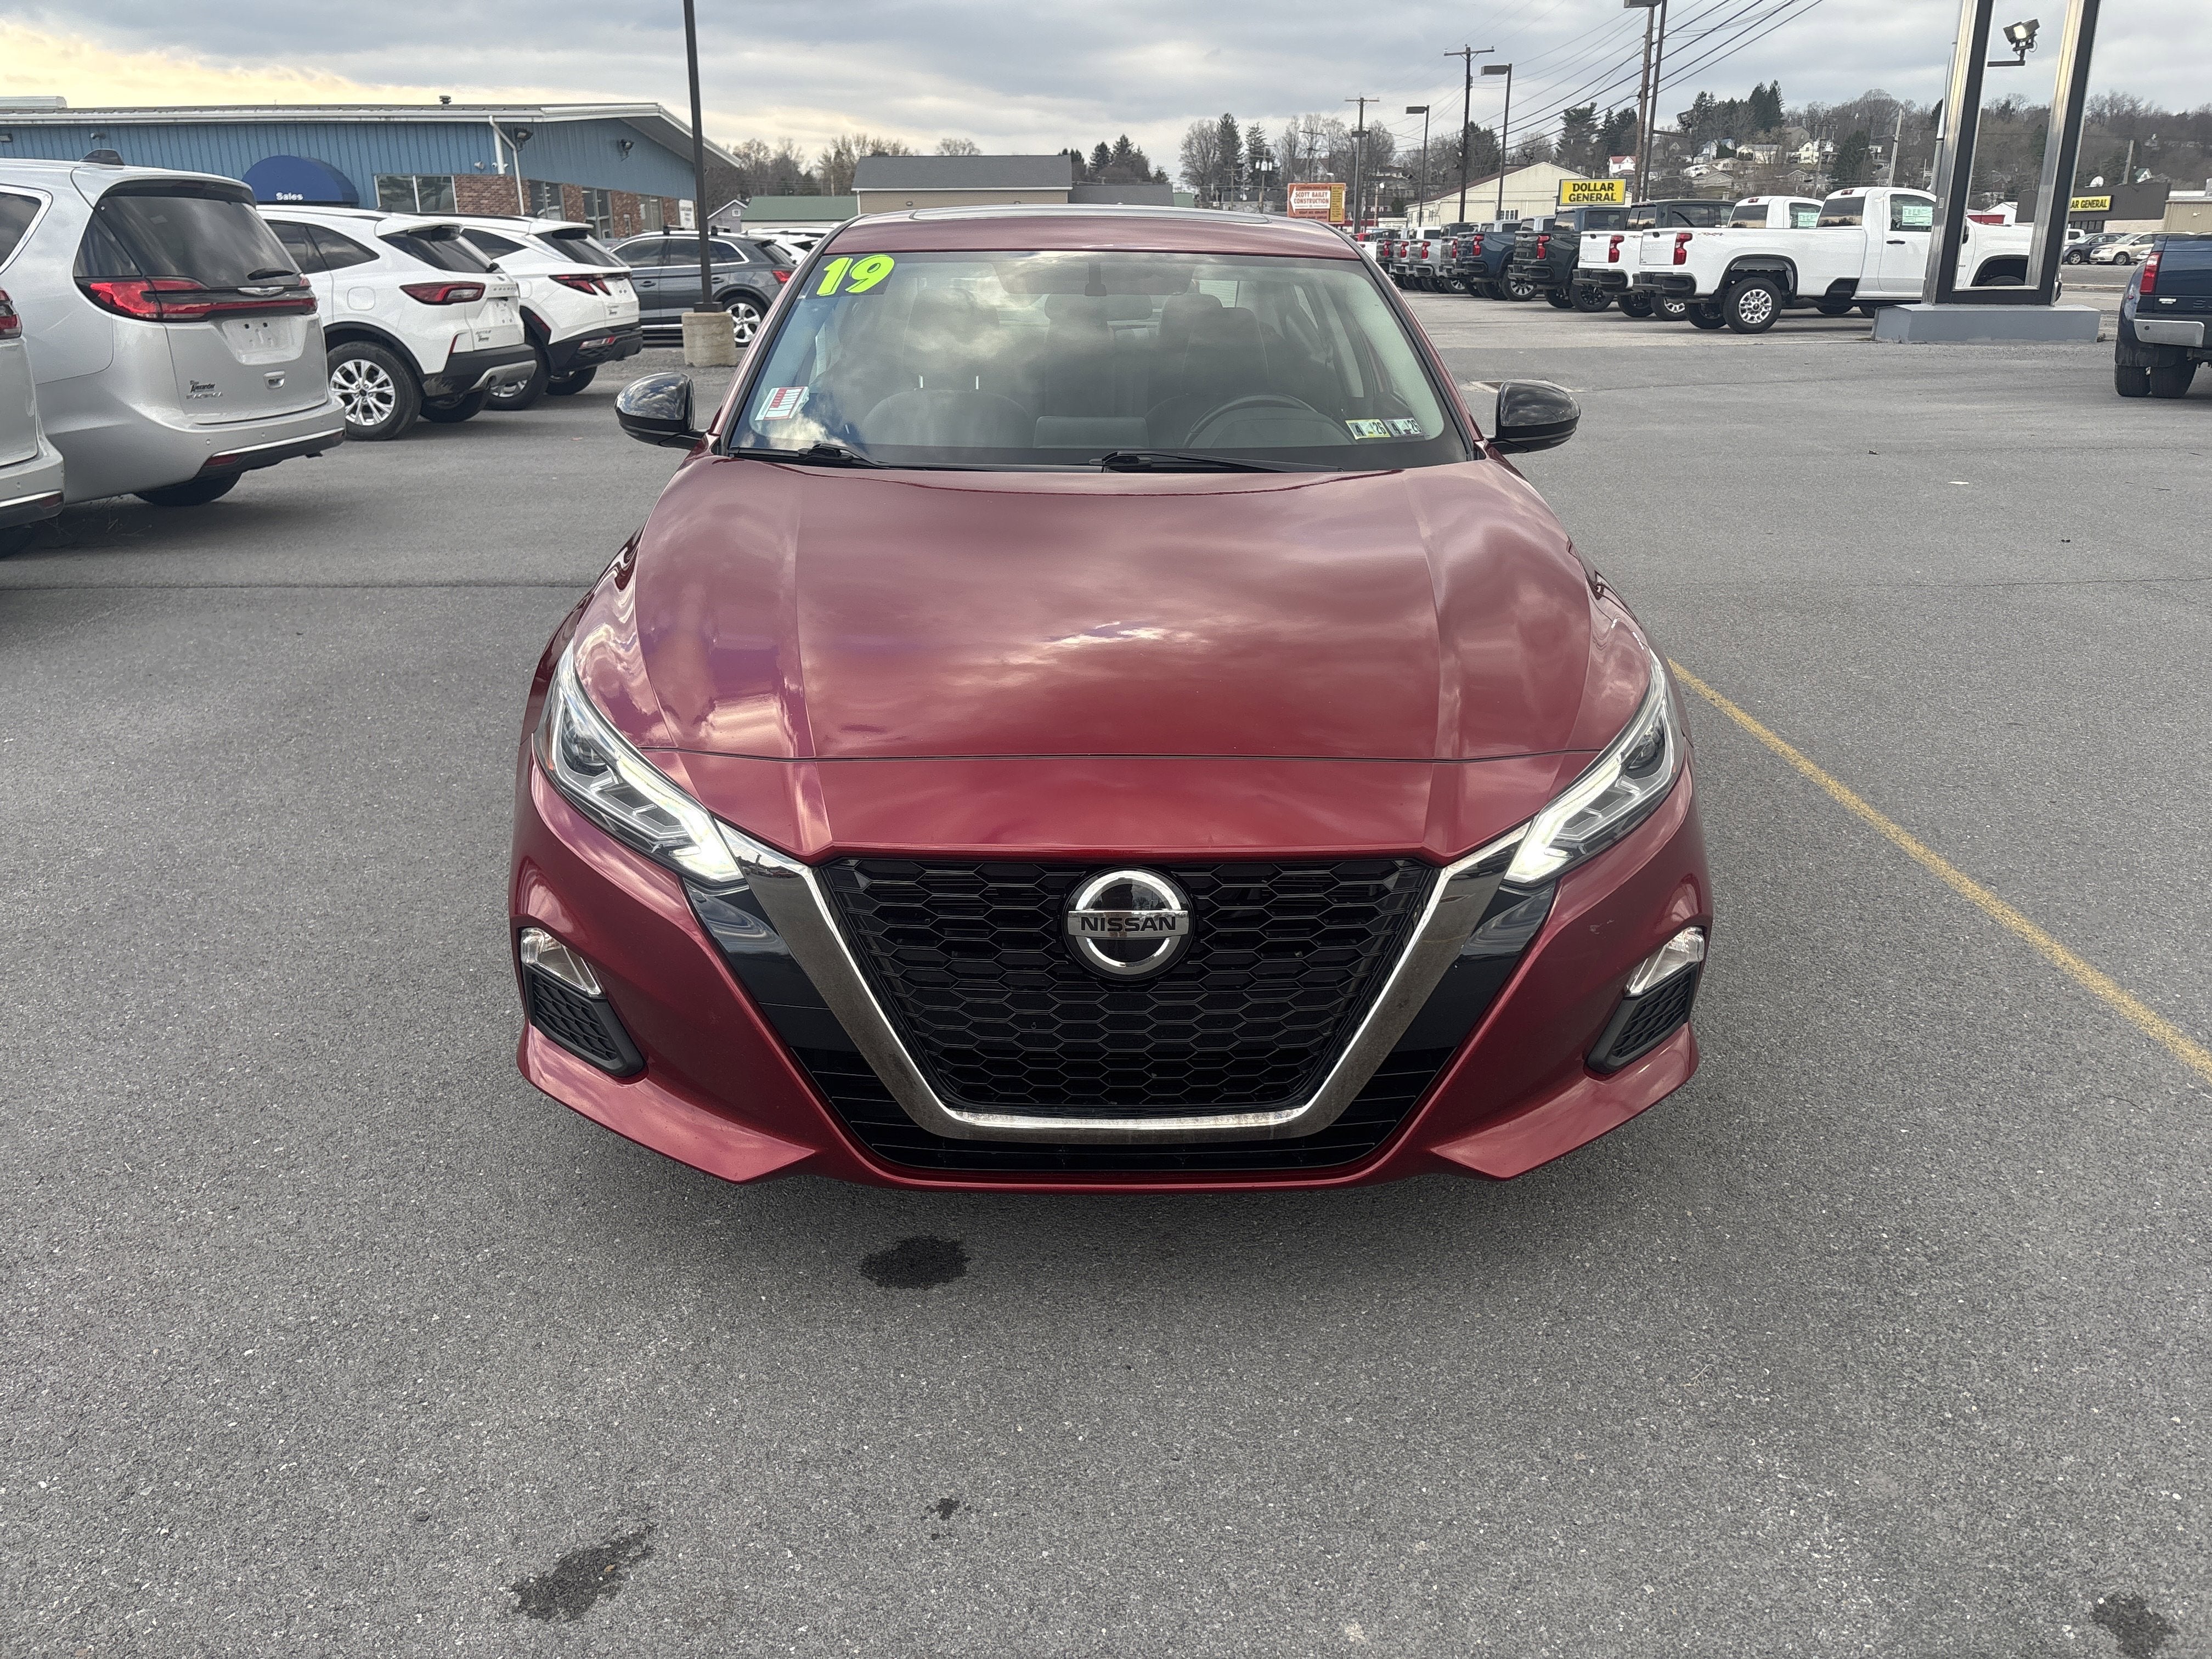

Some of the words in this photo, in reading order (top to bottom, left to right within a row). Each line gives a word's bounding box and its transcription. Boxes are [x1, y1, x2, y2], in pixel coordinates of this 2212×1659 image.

[1572, 183, 1615, 192] DOLLAR
[276, 192, 303, 200] Sales
[1568, 193, 1617, 202] GENERAL
[2081, 199, 2107, 208] GENERAL
[816, 254, 895, 296] 19
[1081, 917, 1176, 932] NISSAN
